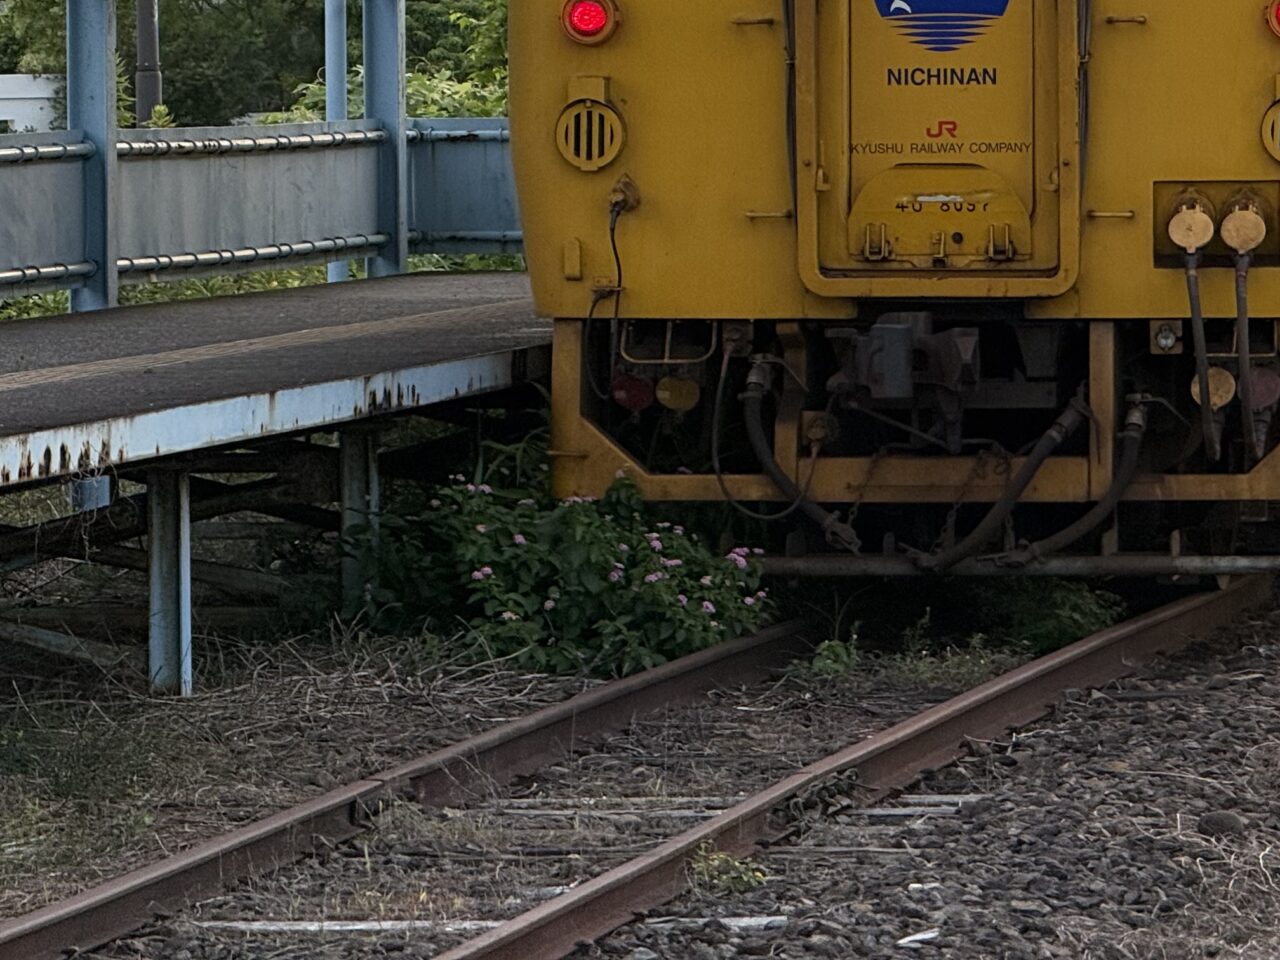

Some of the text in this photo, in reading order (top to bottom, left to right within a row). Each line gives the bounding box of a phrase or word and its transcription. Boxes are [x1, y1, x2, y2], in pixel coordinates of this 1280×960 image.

[887, 68, 997, 85] NICHINAN
[926, 121, 957, 138] JR
[850, 142, 1032, 154] KYUSHU RAILWAY COMPANY
